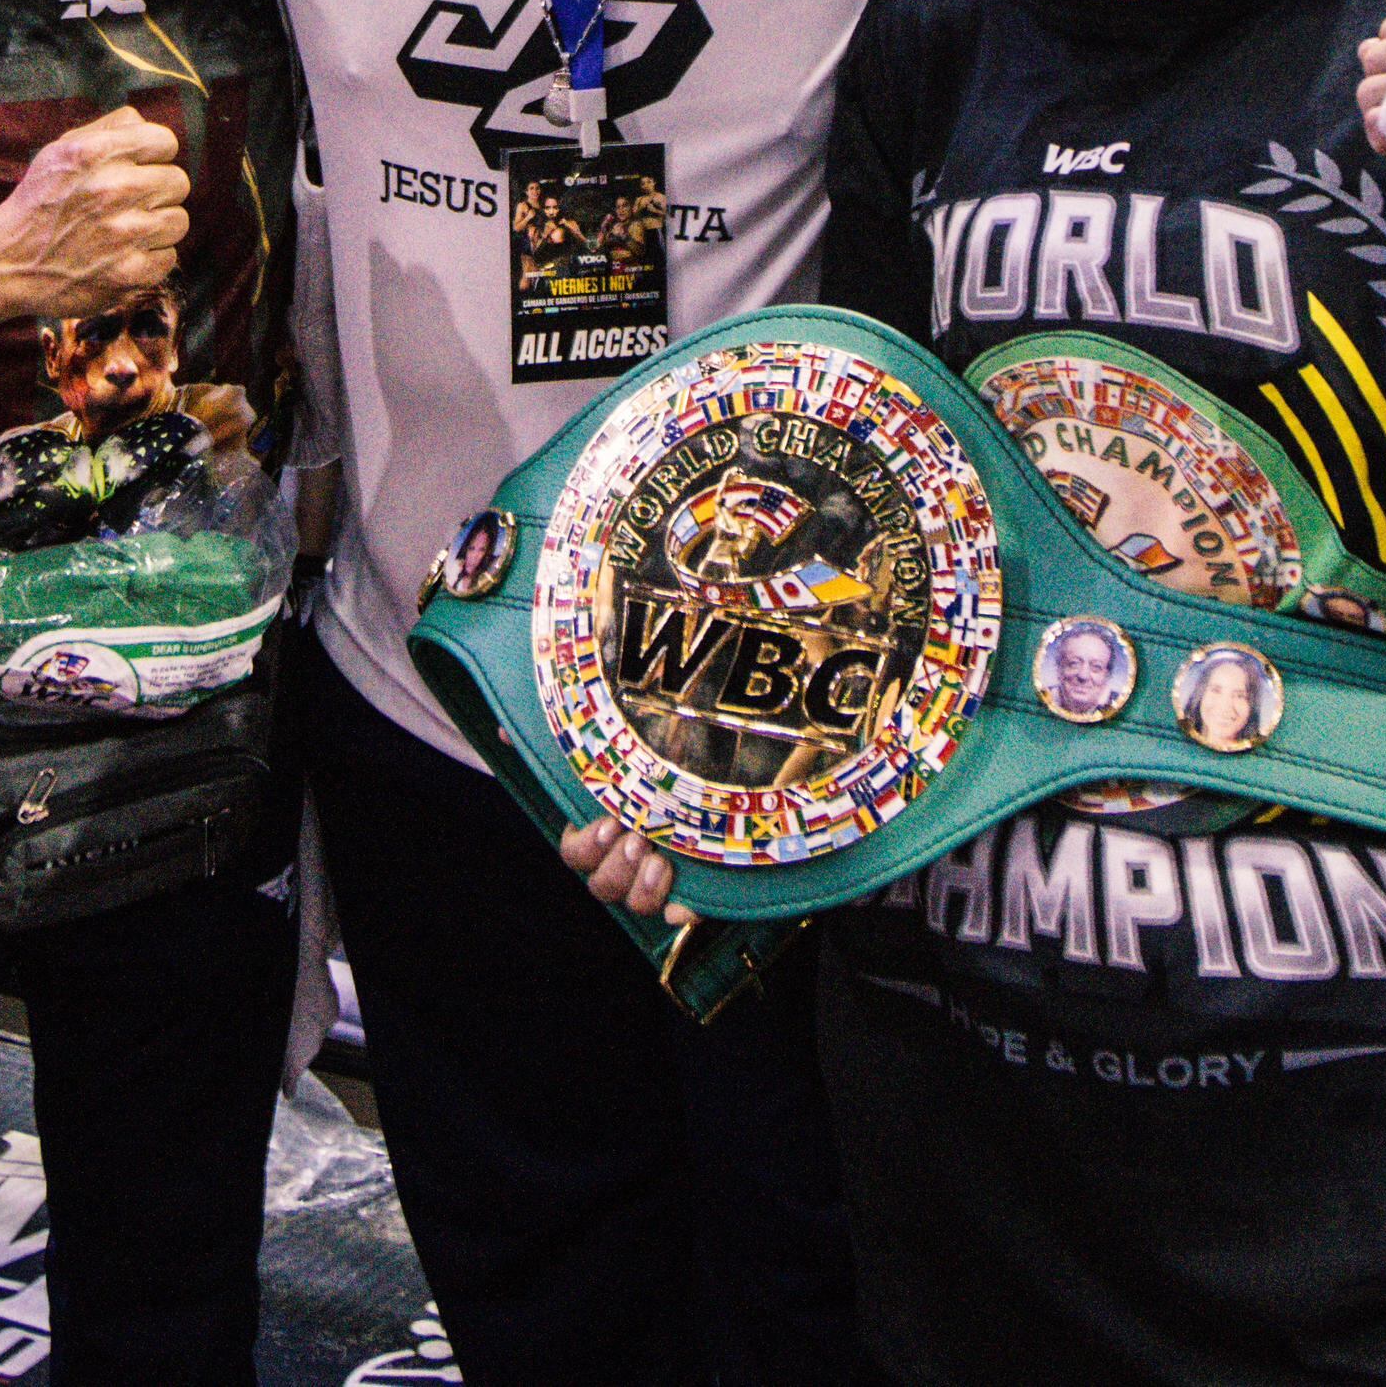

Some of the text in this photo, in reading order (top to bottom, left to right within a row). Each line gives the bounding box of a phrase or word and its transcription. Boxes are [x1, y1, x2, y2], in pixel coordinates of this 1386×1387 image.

[1043, 142, 1131, 175] WBC
[380, 159, 499, 217] JESUS
[550, 277, 598, 296] VIERNES
[924, 189, 1301, 354] WORLD
[517, 324, 668, 365] ALL ACCESS
[608, 416, 928, 630] WORLD CHAMPION
[1056, 422, 1240, 587] CHAMPION
[152, 644, 181, 655] DEAR
[619, 598, 886, 735] WBC
[1093, 1050, 1267, 1090] GLORY
